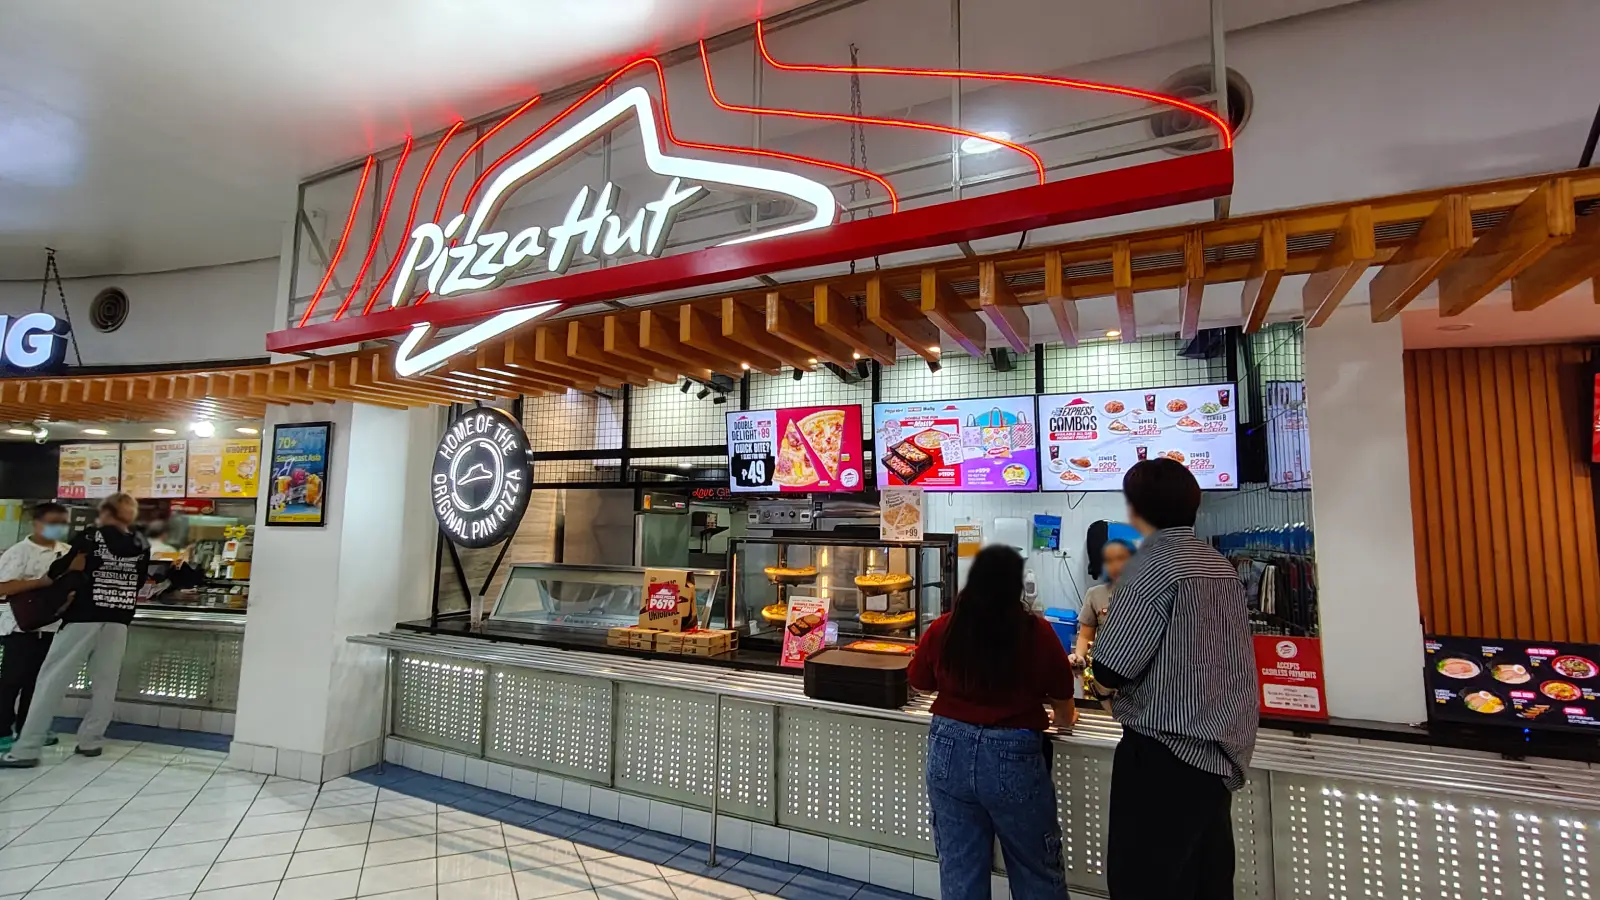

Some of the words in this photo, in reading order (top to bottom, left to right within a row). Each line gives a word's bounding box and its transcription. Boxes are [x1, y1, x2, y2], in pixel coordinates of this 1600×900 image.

[392, 214, 545, 307] Pizza
[548, 177, 702, 272] Hut
[1062, 406, 1095, 416] EXPRESS
[734, 421, 753, 430] DOUBLE
[1050, 416, 1098, 432] COMBOS
[439, 417, 475, 460] HOME
[476, 414, 494, 433] OF
[493, 422, 518, 456] THE
[732, 430, 757, 441] DELIGHT
[735, 443, 753, 453] QUICK
[753, 442, 770, 453] BITE?
[434, 473, 469, 539] ORIGINAL
[472, 514, 498, 540] PAN
[494, 469, 522, 522] PIZZA
[1276, 662, 1300, 671] ACCEPTS
[1261, 667, 1288, 677] CASHLESS
[1288, 670, 1317, 679] PAYMENTS
